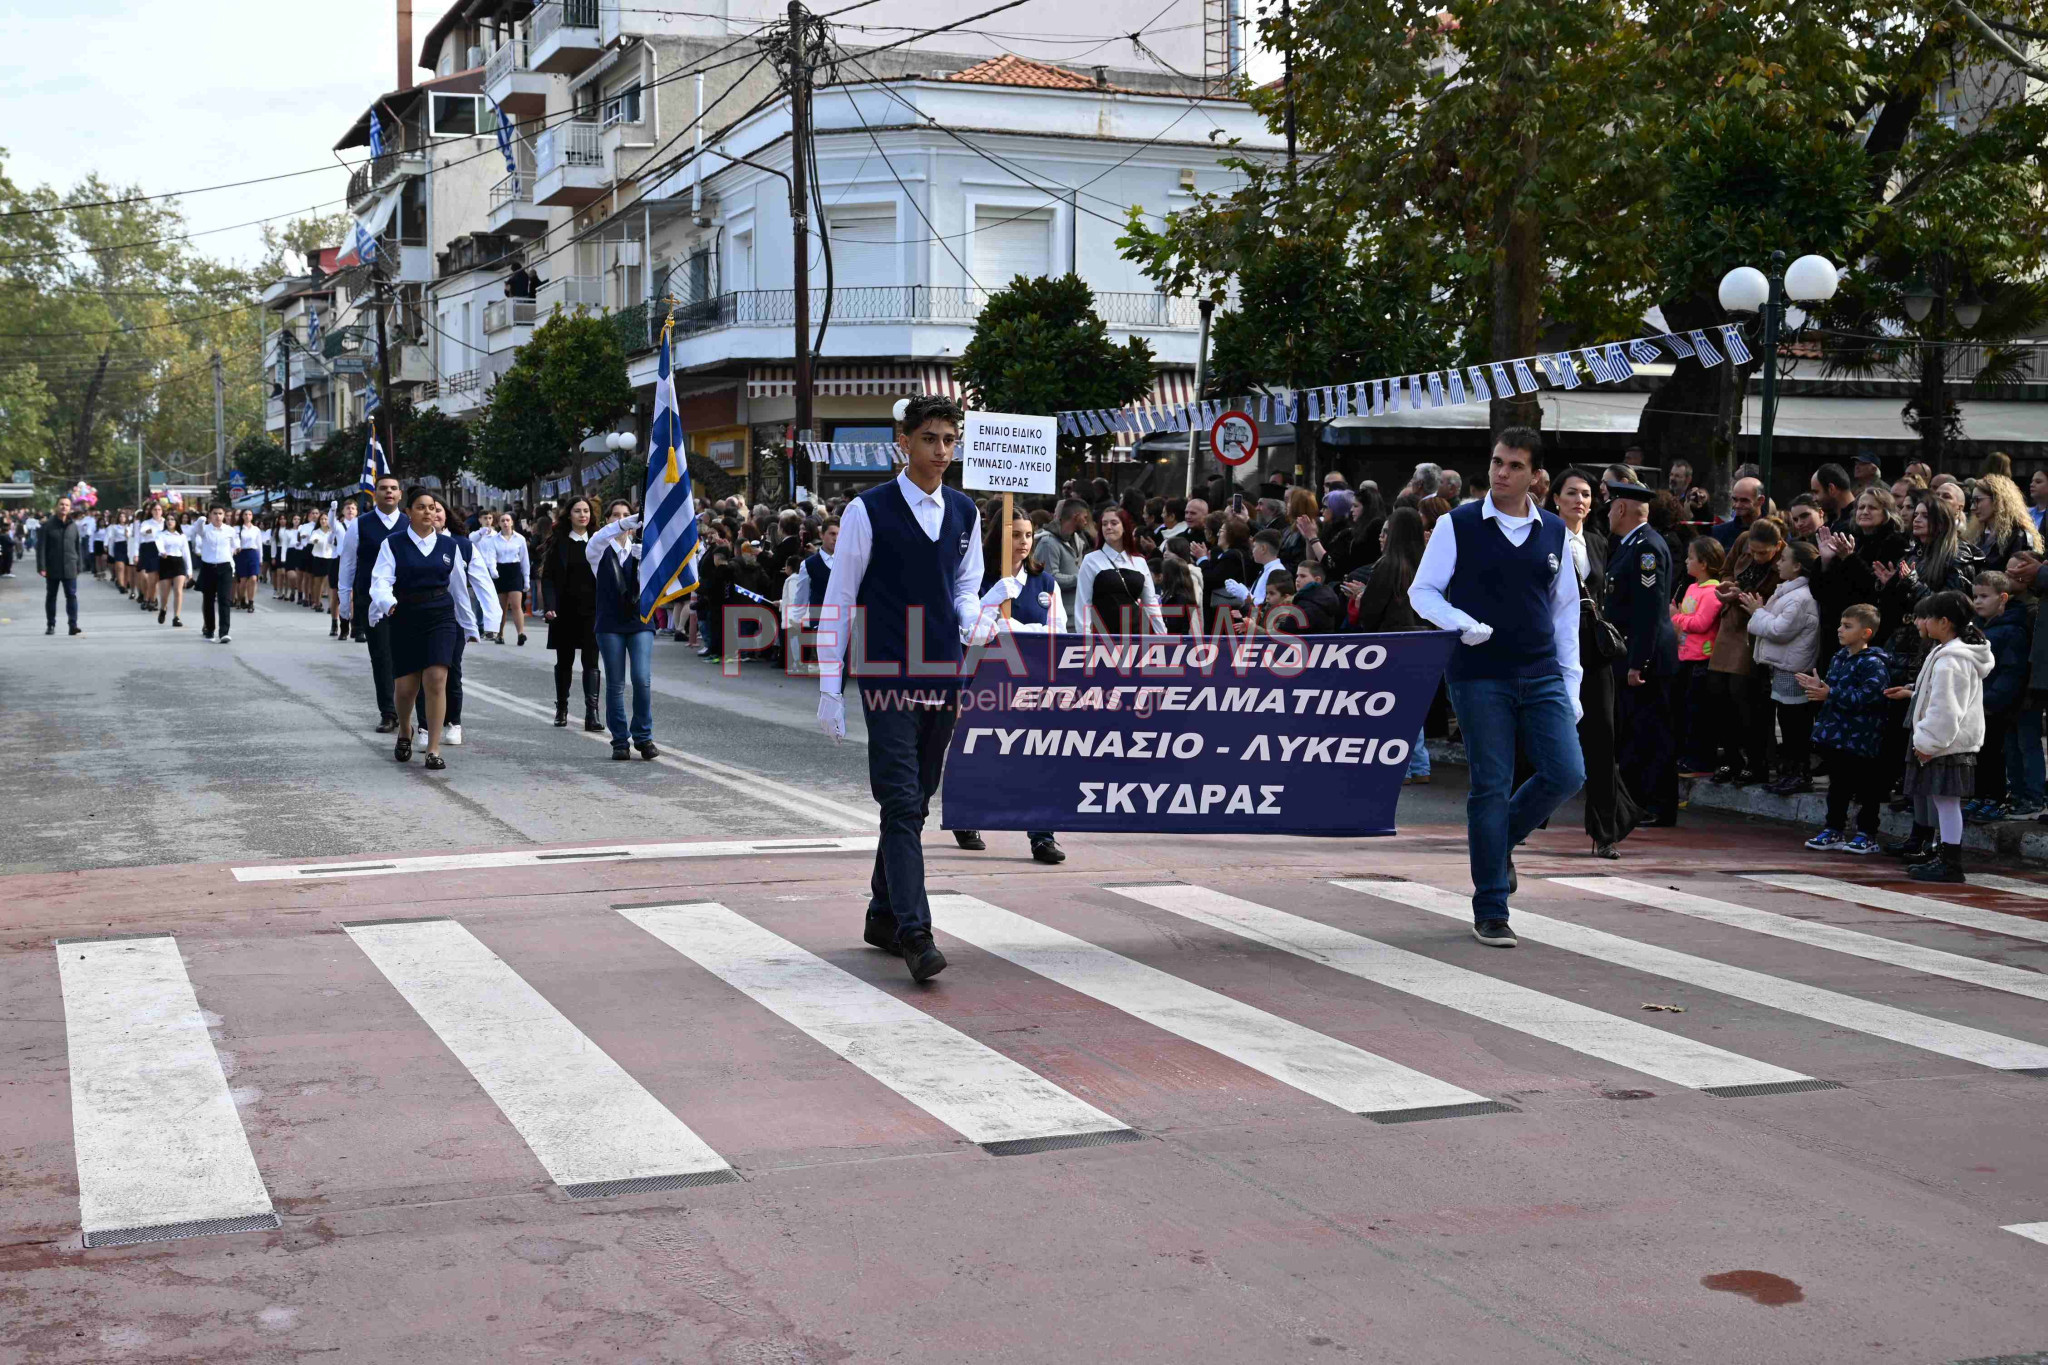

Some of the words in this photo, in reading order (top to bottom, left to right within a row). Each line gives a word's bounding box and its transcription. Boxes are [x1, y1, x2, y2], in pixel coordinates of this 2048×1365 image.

[979, 425, 1010, 437] ΕΝΙΑΙΟ
[1012, 427, 1043, 439] ΕΙΔΙΚΟ
[973, 441, 1047, 456] ΕΠΑΓΓΕΛΜΑΤΙΚΟ
[967, 457, 1013, 470] ΓΥΜΝΑΣΙΟ
[1019, 461, 1052, 473] ΛΥΚΕΙΟ
[989, 475, 1029, 488] ΣΚΥΔΡΑΣ
[1057, 643, 1219, 669] ΕΝΙΑΙΟ
[1230, 643, 1388, 670] ΕΙΔΙΚΟ
[1010, 686, 1396, 717] ΕΠΑΓΓΕΛΜΑΤΙΚΟ
[963, 727, 1204, 759] ΓΥΜΝΑΣΙΟ
[1216, 746, 1230, 754] -
[1239, 734, 1410, 766] ΛΥΚΕΙΟ
[1076, 782, 1285, 815] ΣΚΥΔΡΑΣ
